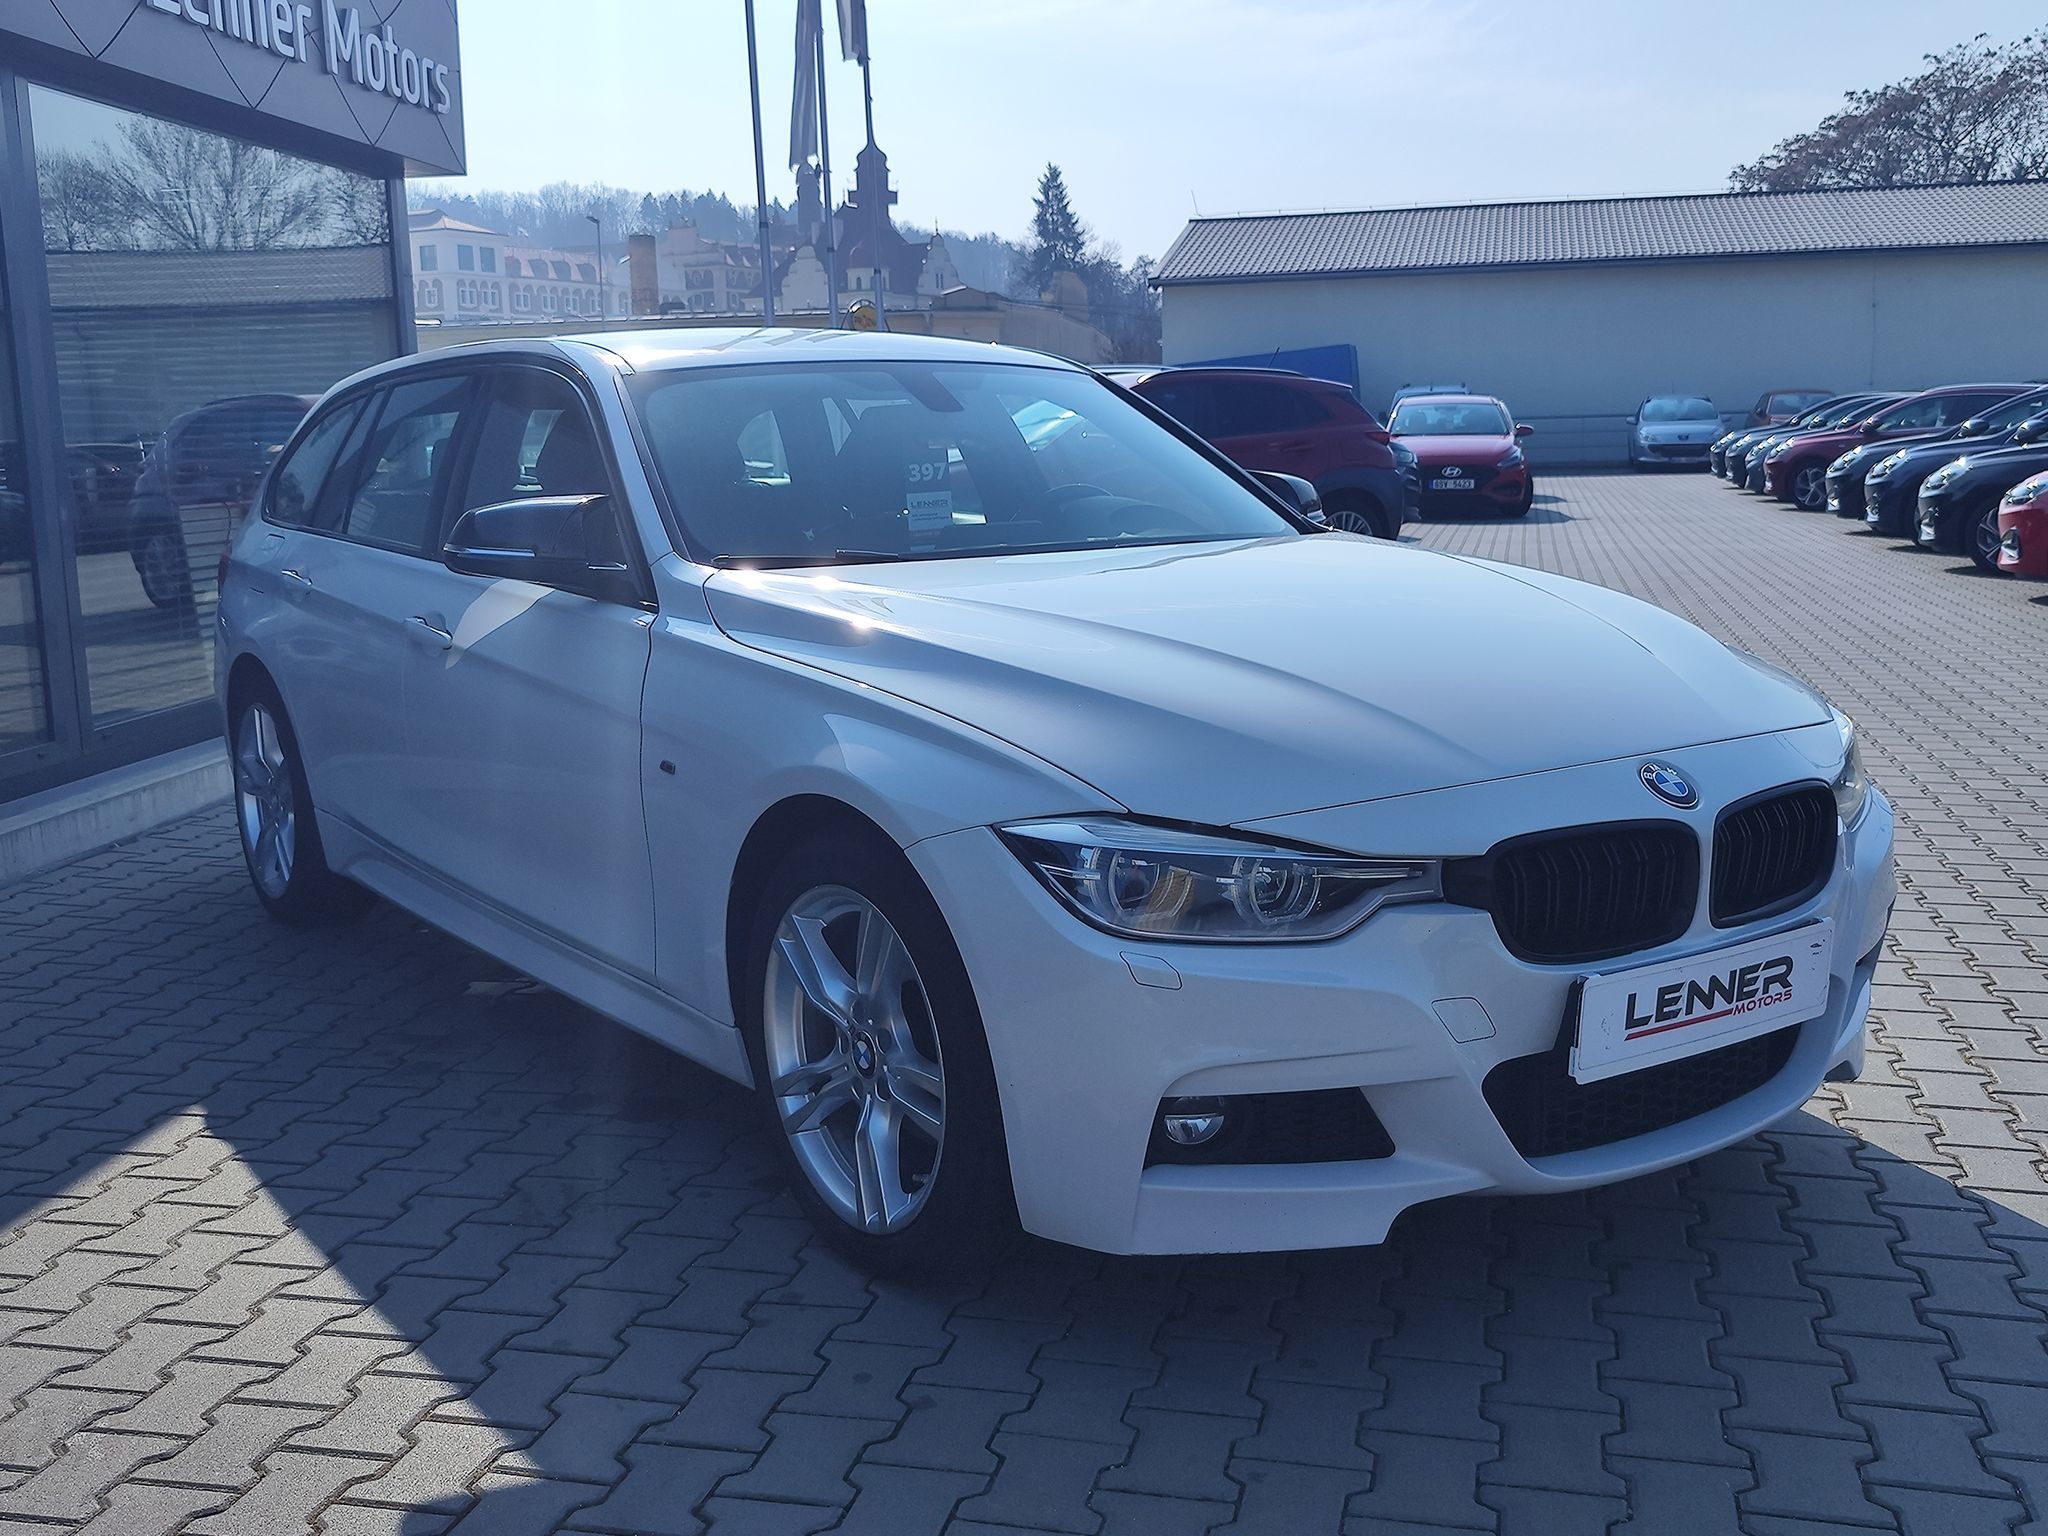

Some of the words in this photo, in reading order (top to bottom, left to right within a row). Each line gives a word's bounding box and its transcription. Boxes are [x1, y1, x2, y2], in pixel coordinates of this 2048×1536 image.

[146, 0, 312, 63] nner
[322, 0, 450, 114] Motors
[908, 462, 947, 482] 397
[1624, 955, 1795, 1031] LENNER
[1732, 989, 1793, 1016] MOTORS
